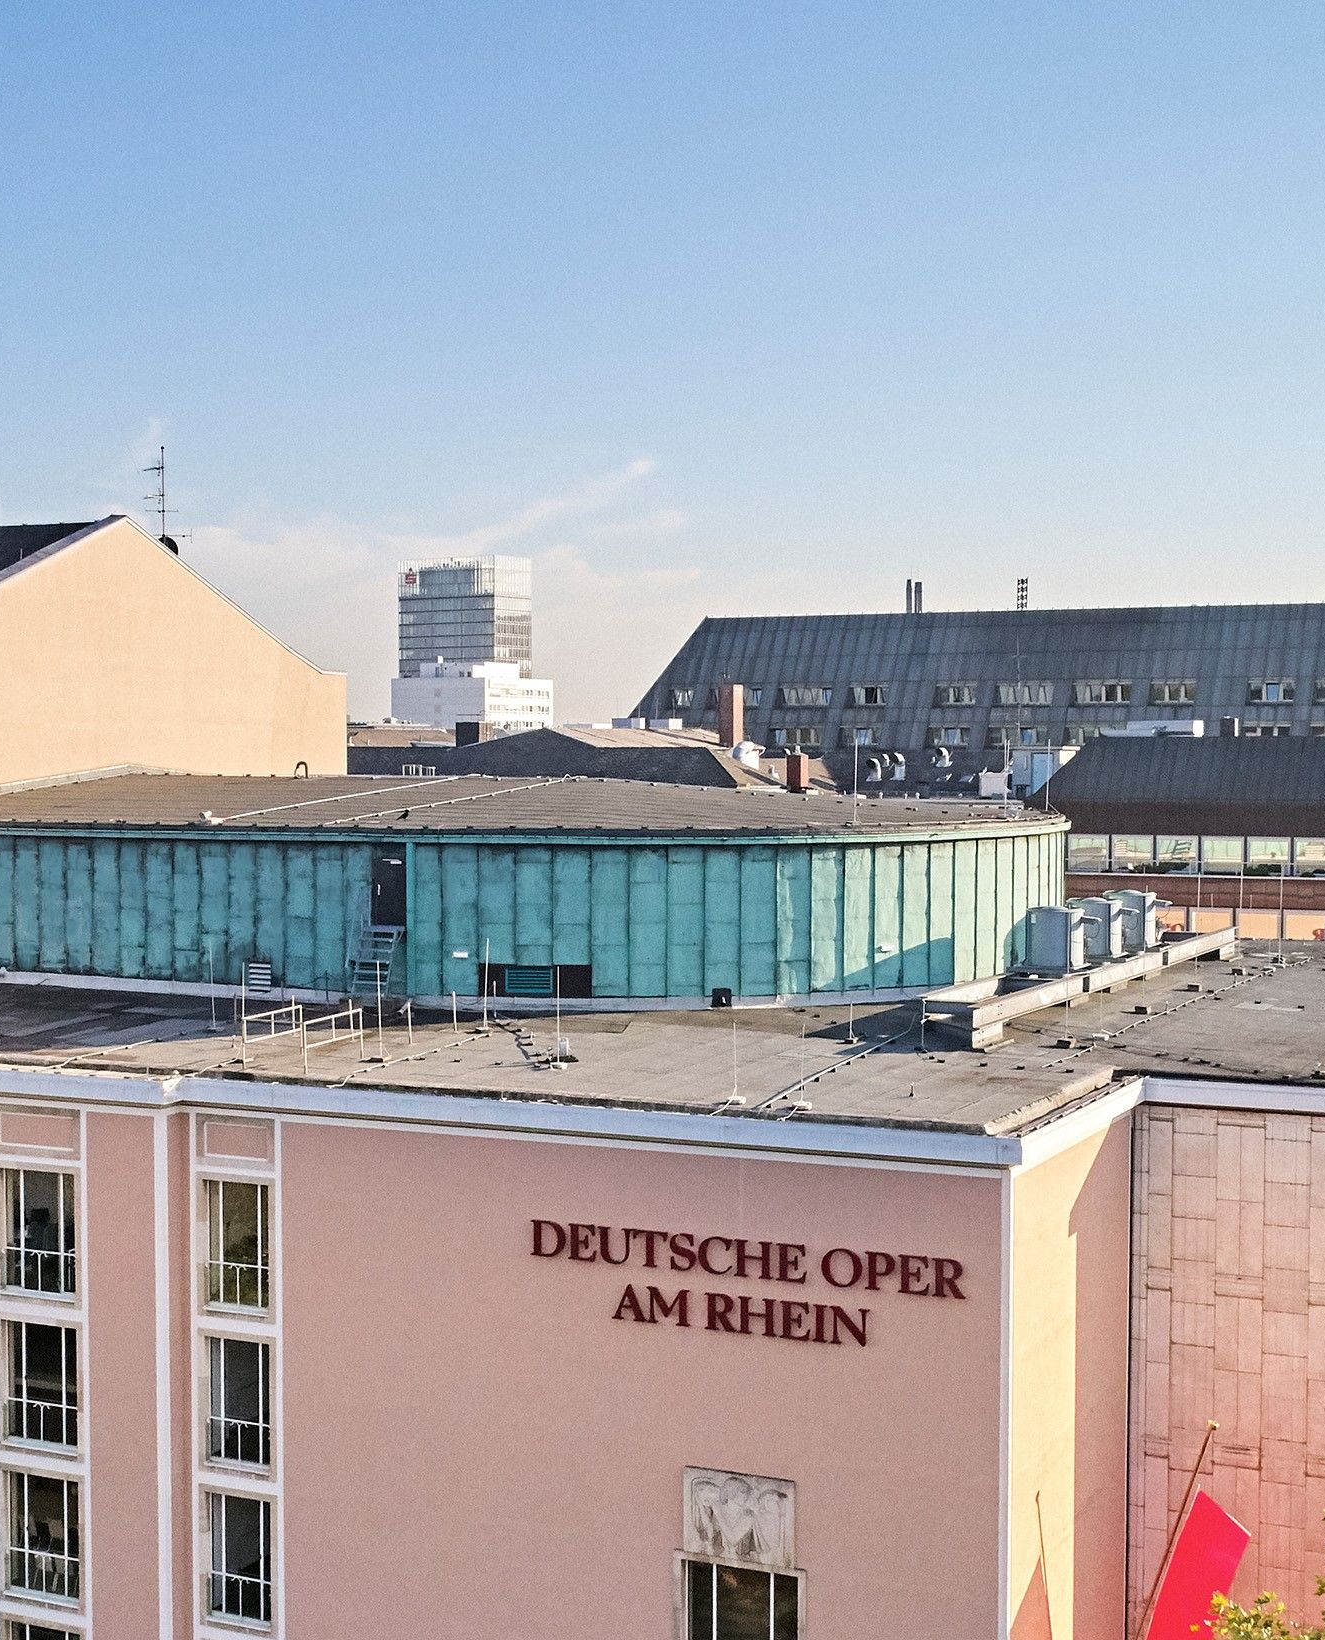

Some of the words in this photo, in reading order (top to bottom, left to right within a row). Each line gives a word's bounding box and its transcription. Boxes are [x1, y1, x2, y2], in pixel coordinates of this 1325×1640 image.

[529, 1218, 808, 1285] DEUTSCHE
[819, 1247, 967, 1301] OPER
[611, 1282, 692, 1328] AM
[703, 1291, 871, 1348] RHEIN
